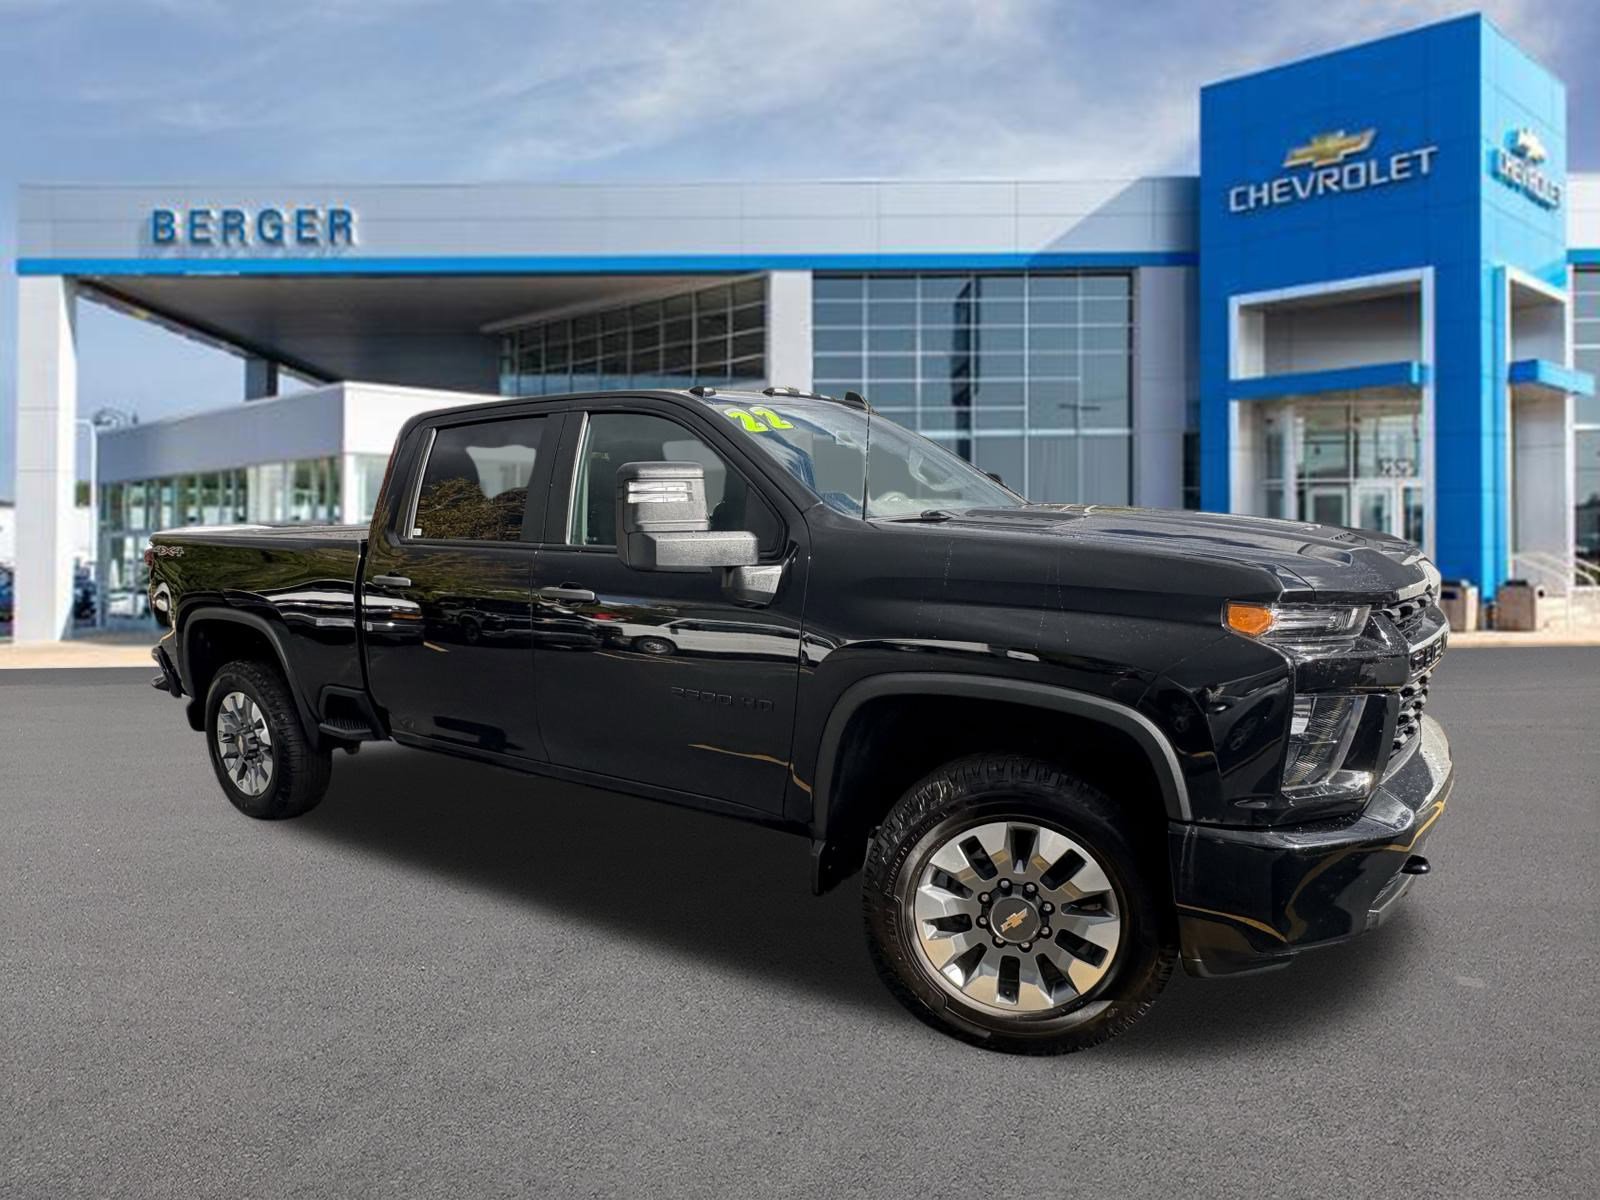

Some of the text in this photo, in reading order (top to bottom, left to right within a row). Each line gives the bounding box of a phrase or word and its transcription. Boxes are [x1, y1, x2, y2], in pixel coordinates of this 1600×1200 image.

[1228, 145, 1439, 214] CHEVROLET
[151, 207, 356, 246] BERGER
[723, 405, 795, 433] 22
